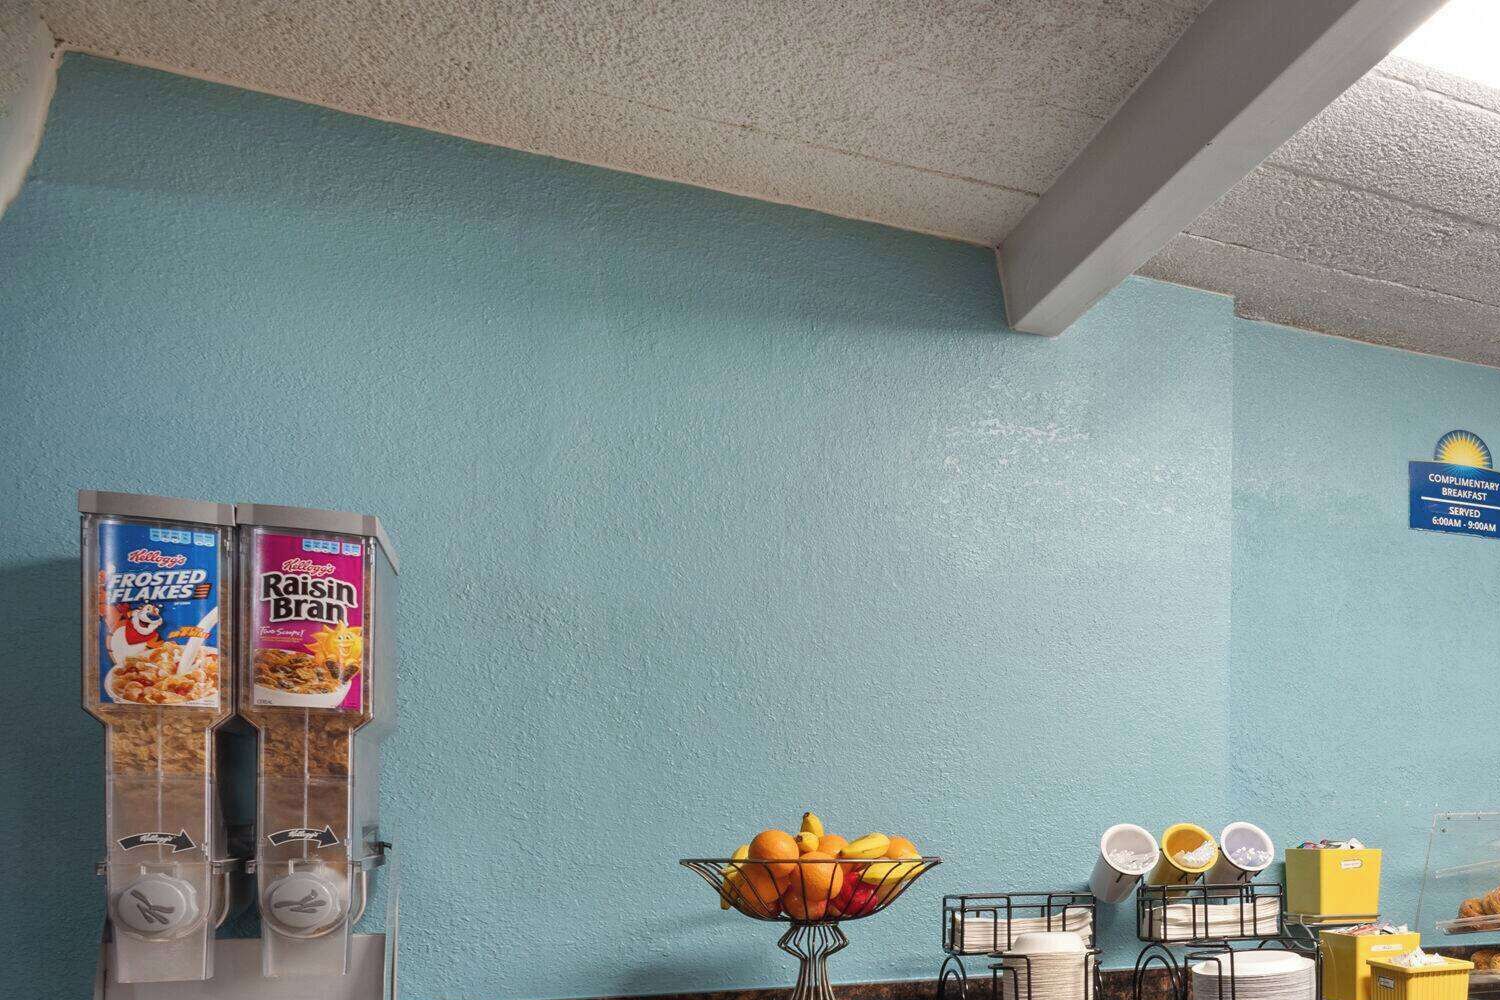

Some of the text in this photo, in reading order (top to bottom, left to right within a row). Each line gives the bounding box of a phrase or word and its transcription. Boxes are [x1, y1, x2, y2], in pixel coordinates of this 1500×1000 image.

[1428, 473, 1500, 491] COMPLIMENTARY
[1442, 487, 1487, 501] BREAKFAST
[1448, 506, 1481, 518] SERVED
[1432, 516, 1462, 528] 6:00AM
[1468, 520, 1497, 532] 9:00AM
[128, 548, 187, 568] Kellogg's
[282, 558, 336, 576] Kellogg's
[109, 570, 206, 588] FROSTED
[109, 584, 194, 603] FLAKES
[261, 573, 357, 607] Raisin
[272, 596, 345, 621] Bran
[139, 832, 172, 843] Kellogg's
[288, 829, 320, 840] Kellogg's
